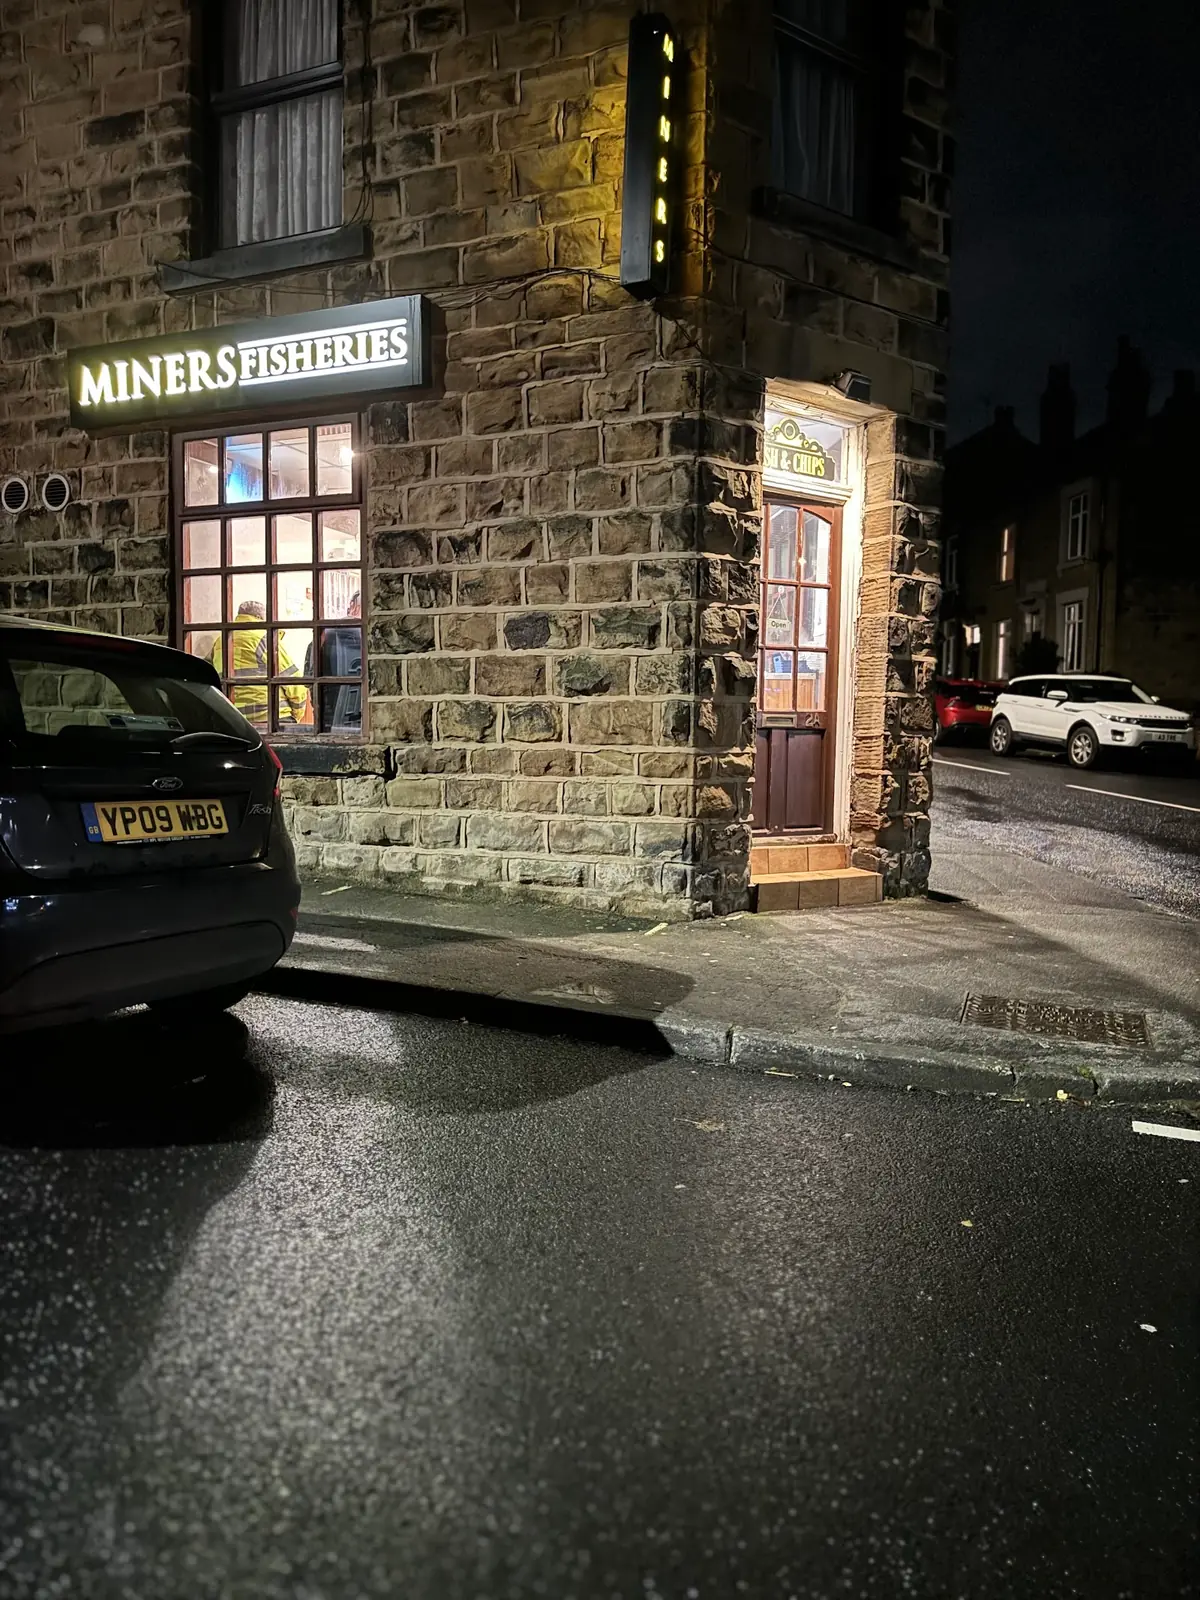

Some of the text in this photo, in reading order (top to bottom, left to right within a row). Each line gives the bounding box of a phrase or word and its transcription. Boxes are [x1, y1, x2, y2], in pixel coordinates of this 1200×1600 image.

[656, 33, 674, 263] MINERS
[78, 326, 408, 406] MINERS FISHERIES
[764, 446, 825, 477] SH & CHIPS
[771, 620, 787, 629] Open
[805, 712, 820, 728] 2A
[88, 825, 99, 834] GB
[101, 803, 223, 836] YP09 WBG
